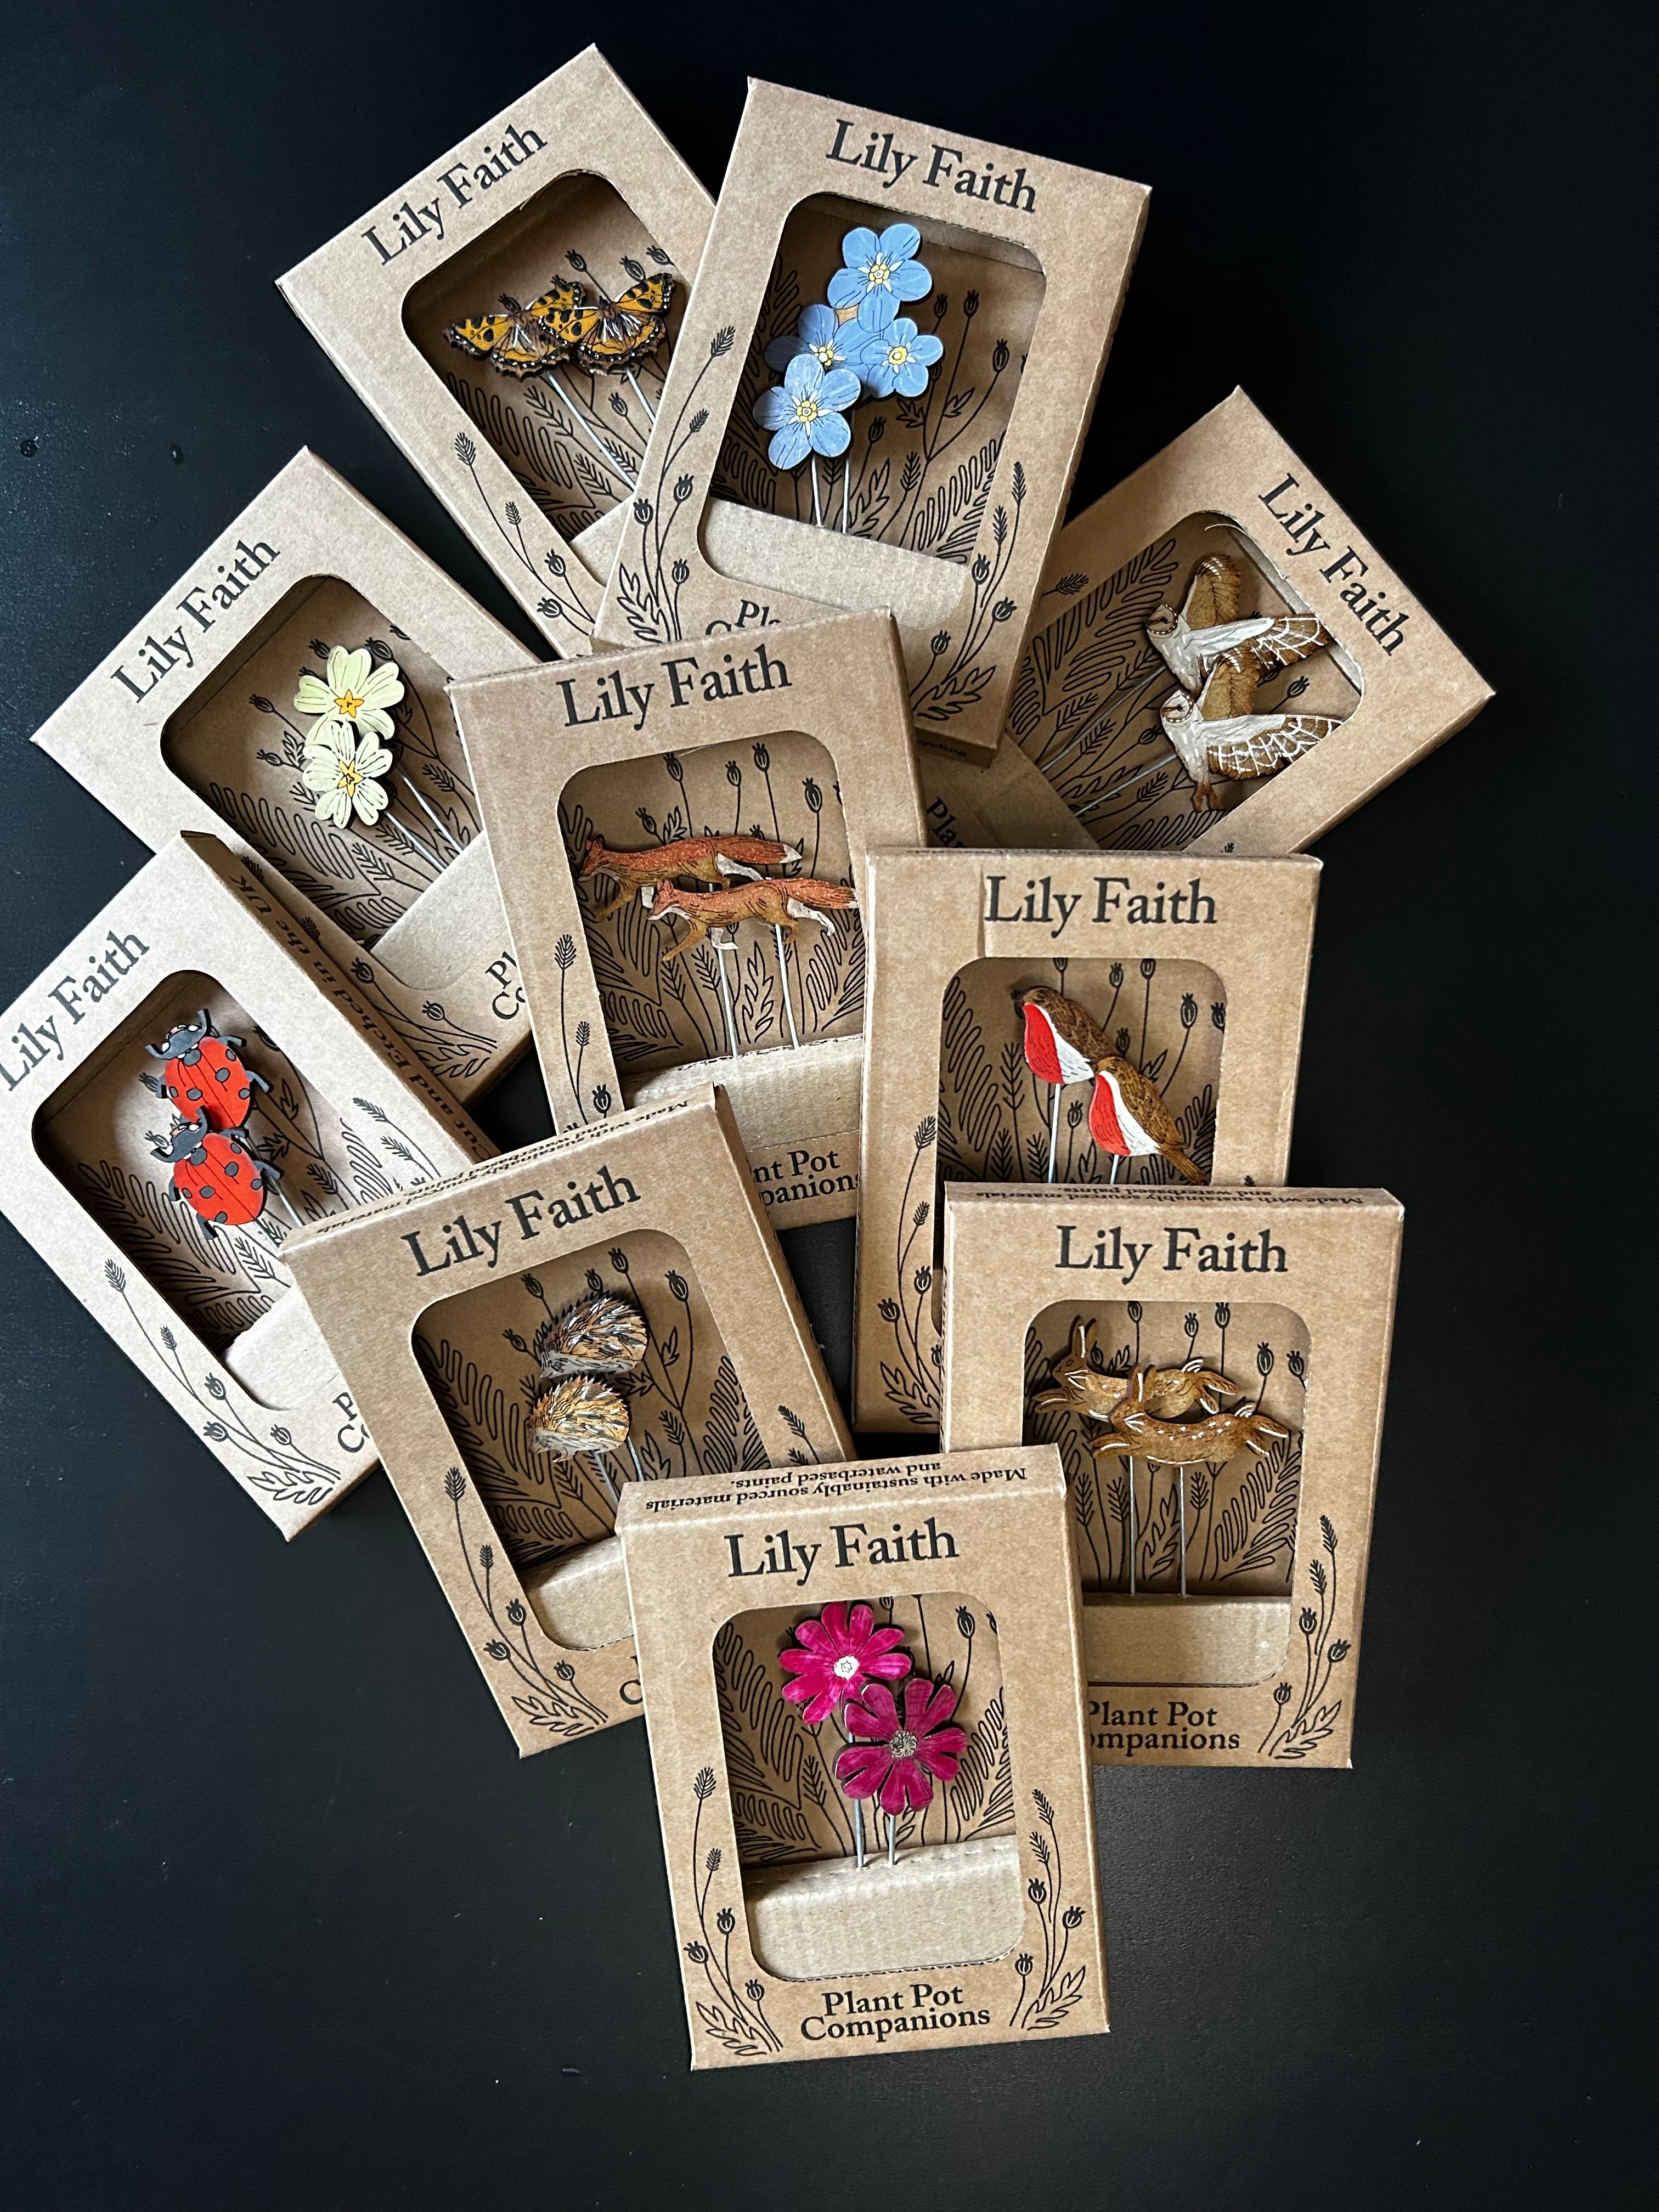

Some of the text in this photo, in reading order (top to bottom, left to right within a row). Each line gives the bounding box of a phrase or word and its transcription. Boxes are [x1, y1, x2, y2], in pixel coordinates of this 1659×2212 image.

[826, 119, 1037, 213] Lily Faith
[361, 124, 548, 265] Lily Faith
[1258, 472, 1409, 657] Lily Faith
[111, 540, 280, 703] Lily Faith
[735, 599, 781, 628] Pl
[556, 670, 654, 730] Lily
[661, 644, 792, 708] Faith
[229, 875, 272, 915] UK
[984, 876, 1217, 939] Lily Faith
[276, 919, 311, 955] the
[314, 961, 337, 983] in
[0, 930, 150, 1091] Lily Faith
[332, 989, 411, 1069] Etched
[409, 1074, 454, 1115] and
[787, 1150, 840, 1177] Pot
[401, 1165, 641, 1277] Lily Faith
[1054, 1225, 1288, 1285] Lily Faith
[645, 1468, 1028, 1513] Made with sustainably sourced materials
[731, 1462, 940, 1488] and waterbased paints.
[724, 1517, 959, 1586] Lily Faith
[1167, 1701, 1218, 1726] Pot
[800, 2007, 990, 2042] Companions
[821, 1983, 963, 2016] Plant Pot
